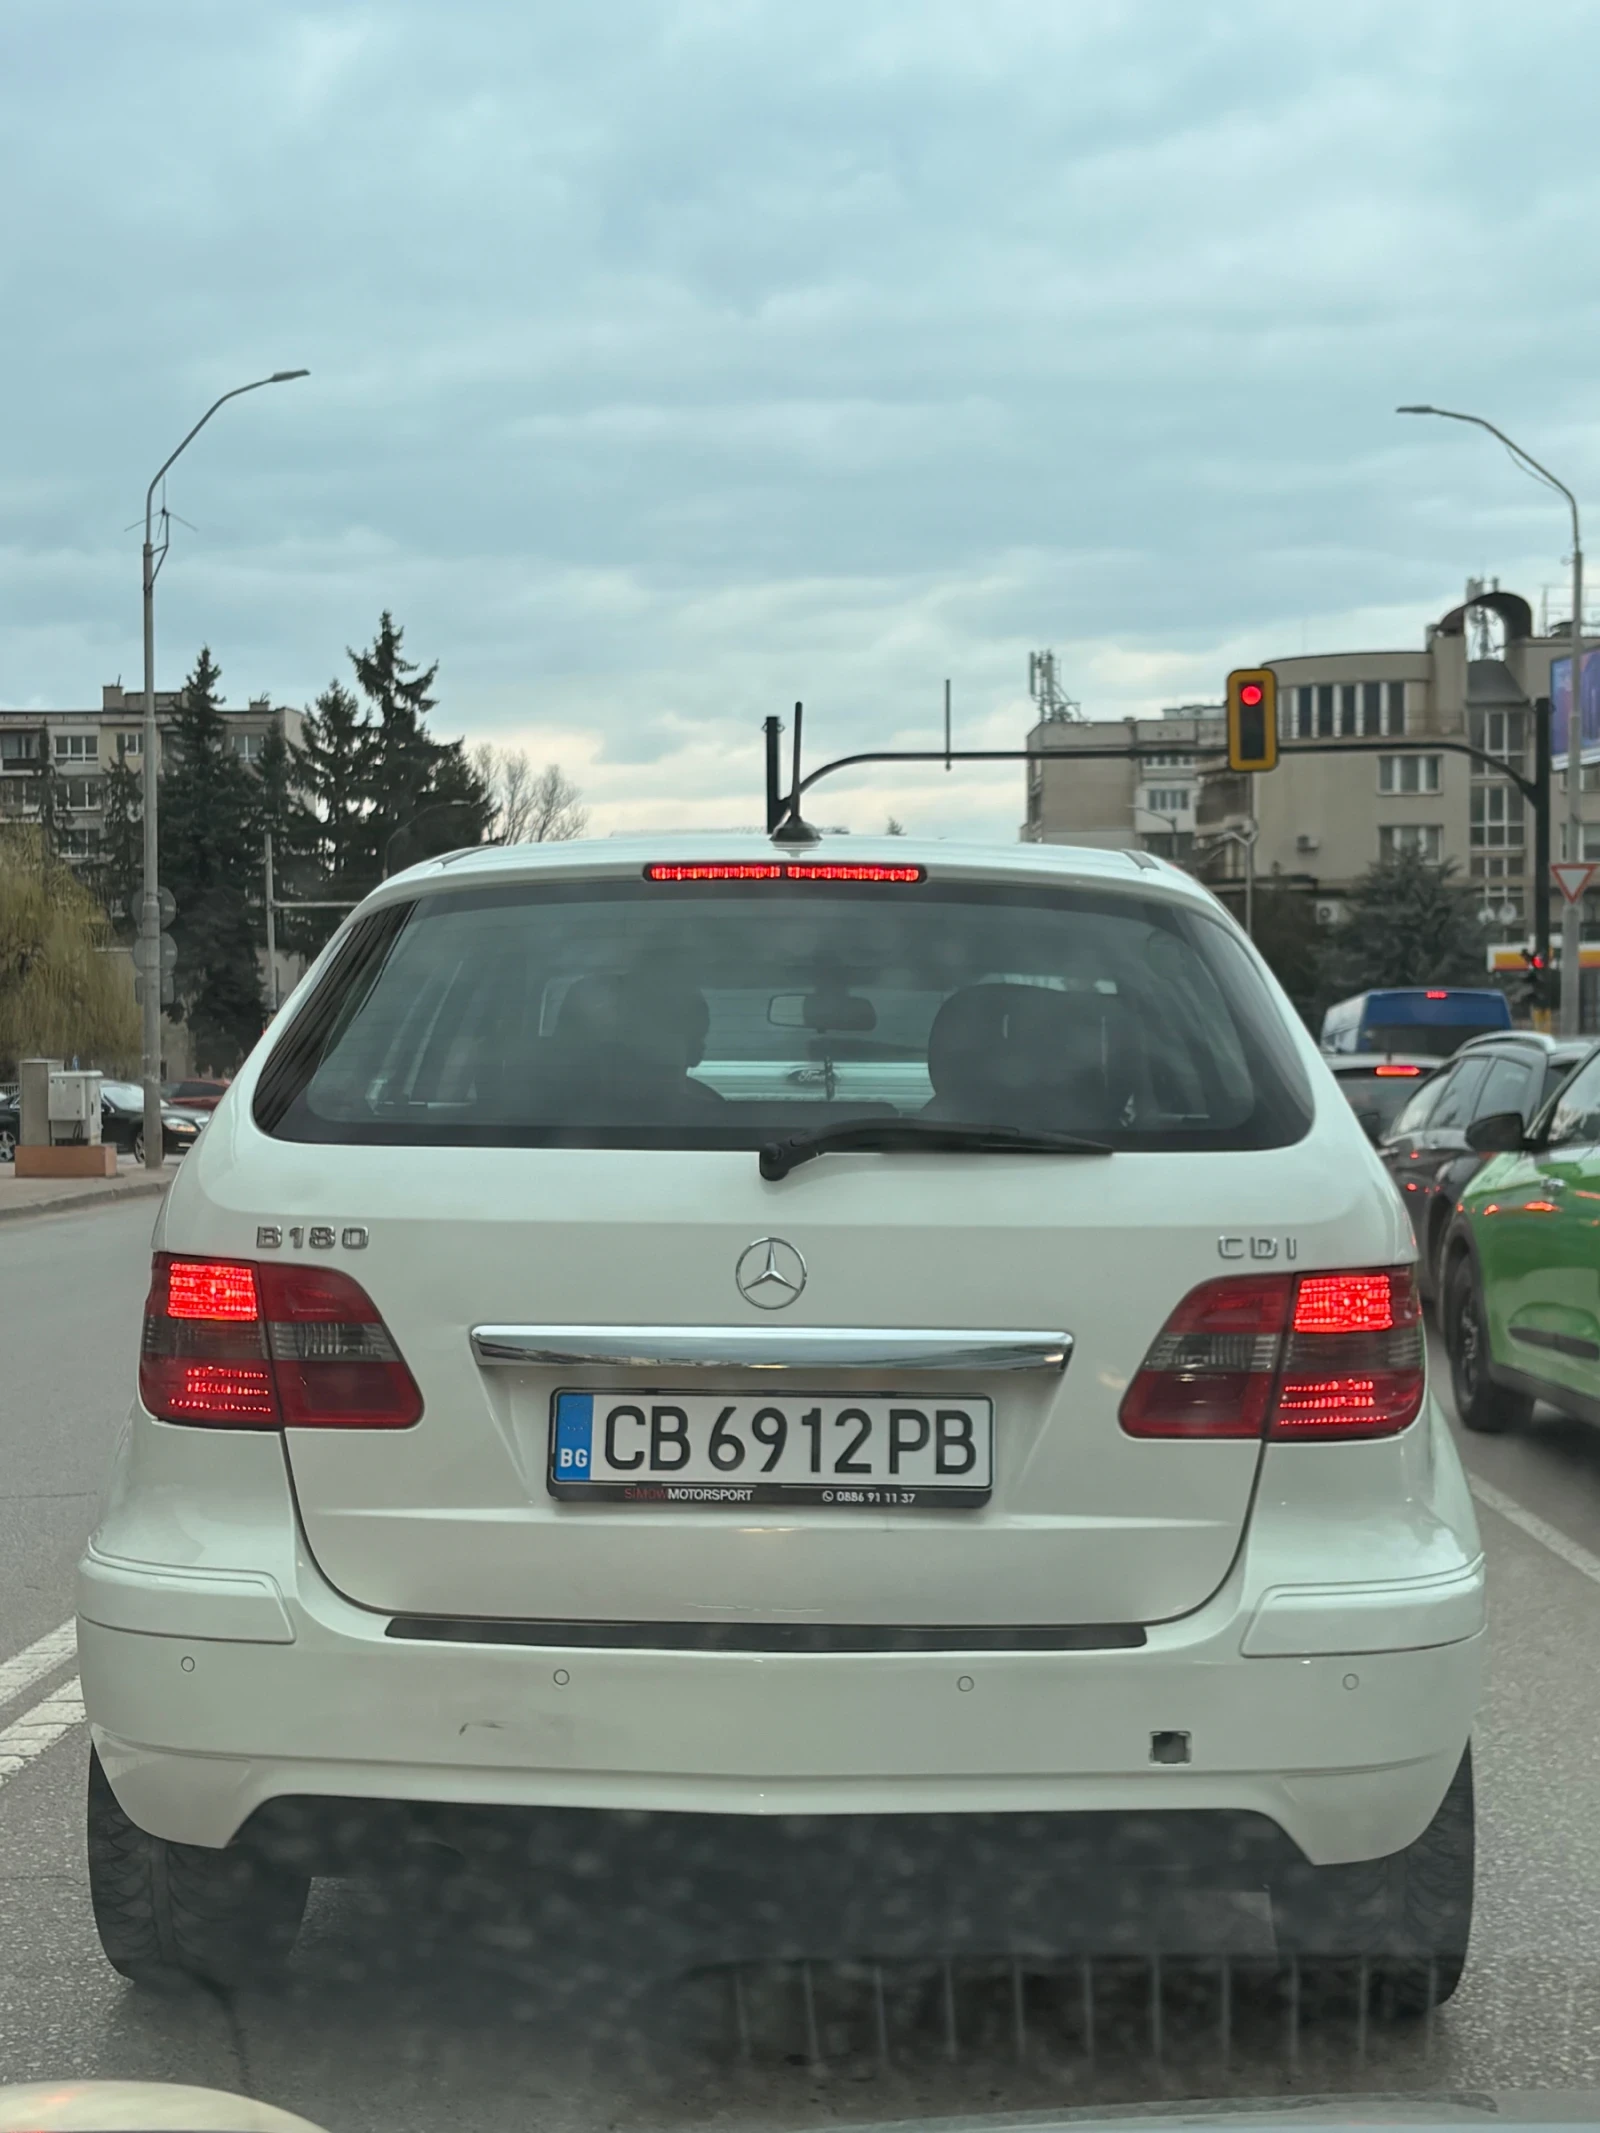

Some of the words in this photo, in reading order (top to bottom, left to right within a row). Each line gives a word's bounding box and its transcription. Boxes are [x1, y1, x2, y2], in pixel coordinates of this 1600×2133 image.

[256, 1226, 369, 1250] B180
[1218, 1236, 1297, 1260] CDI
[560, 1448, 588, 1468] BG
[885, 1493, 897, 1503] 11
[900, 1493, 916, 1504] 37
